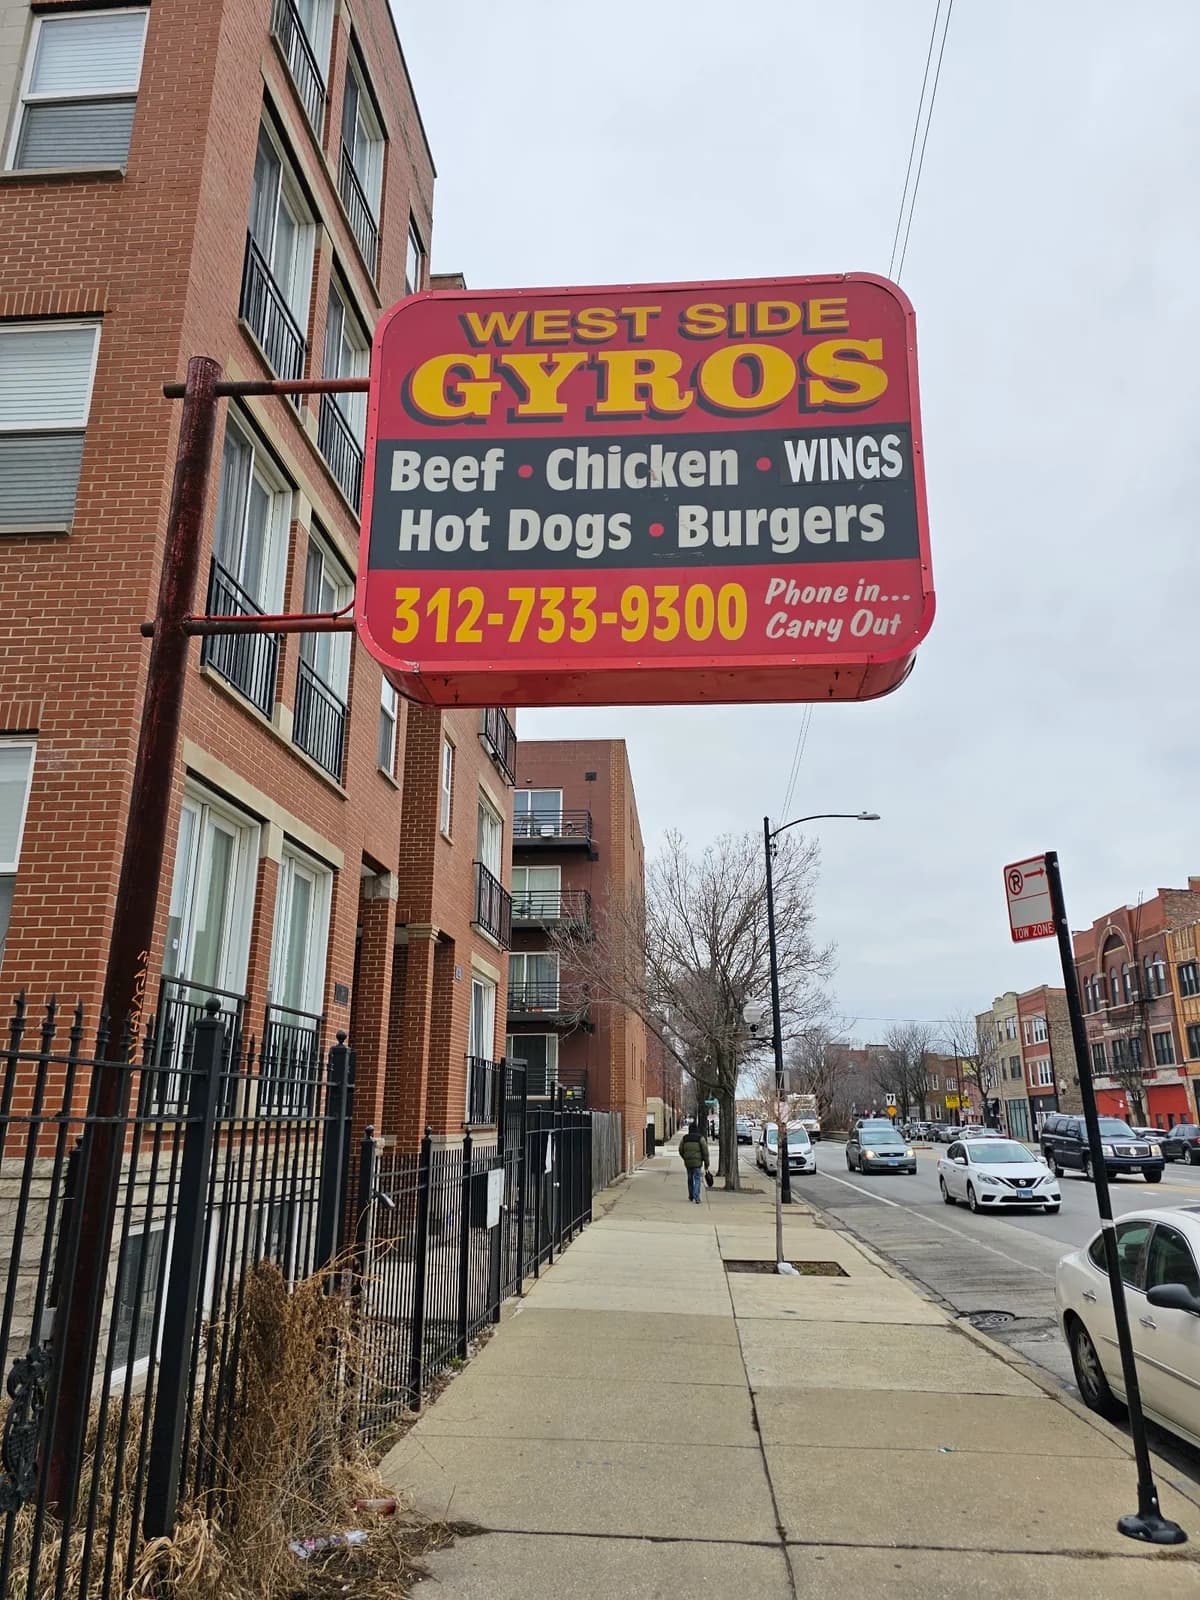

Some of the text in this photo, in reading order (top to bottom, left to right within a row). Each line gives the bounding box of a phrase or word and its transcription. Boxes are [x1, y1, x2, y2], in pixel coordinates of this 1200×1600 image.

[465, 298, 850, 343] WEST SIDE
[408, 339, 888, 419] GYROS
[390, 433, 904, 493] Beef Chicken WINGS
[398, 503, 885, 559] Hot Dogs Burgers
[392, 583, 748, 643] 312-733-9300
[764, 577, 849, 606] Phone
[765, 608, 903, 643] Carry Out
[1014, 922, 1054, 940] TOW ZONE
